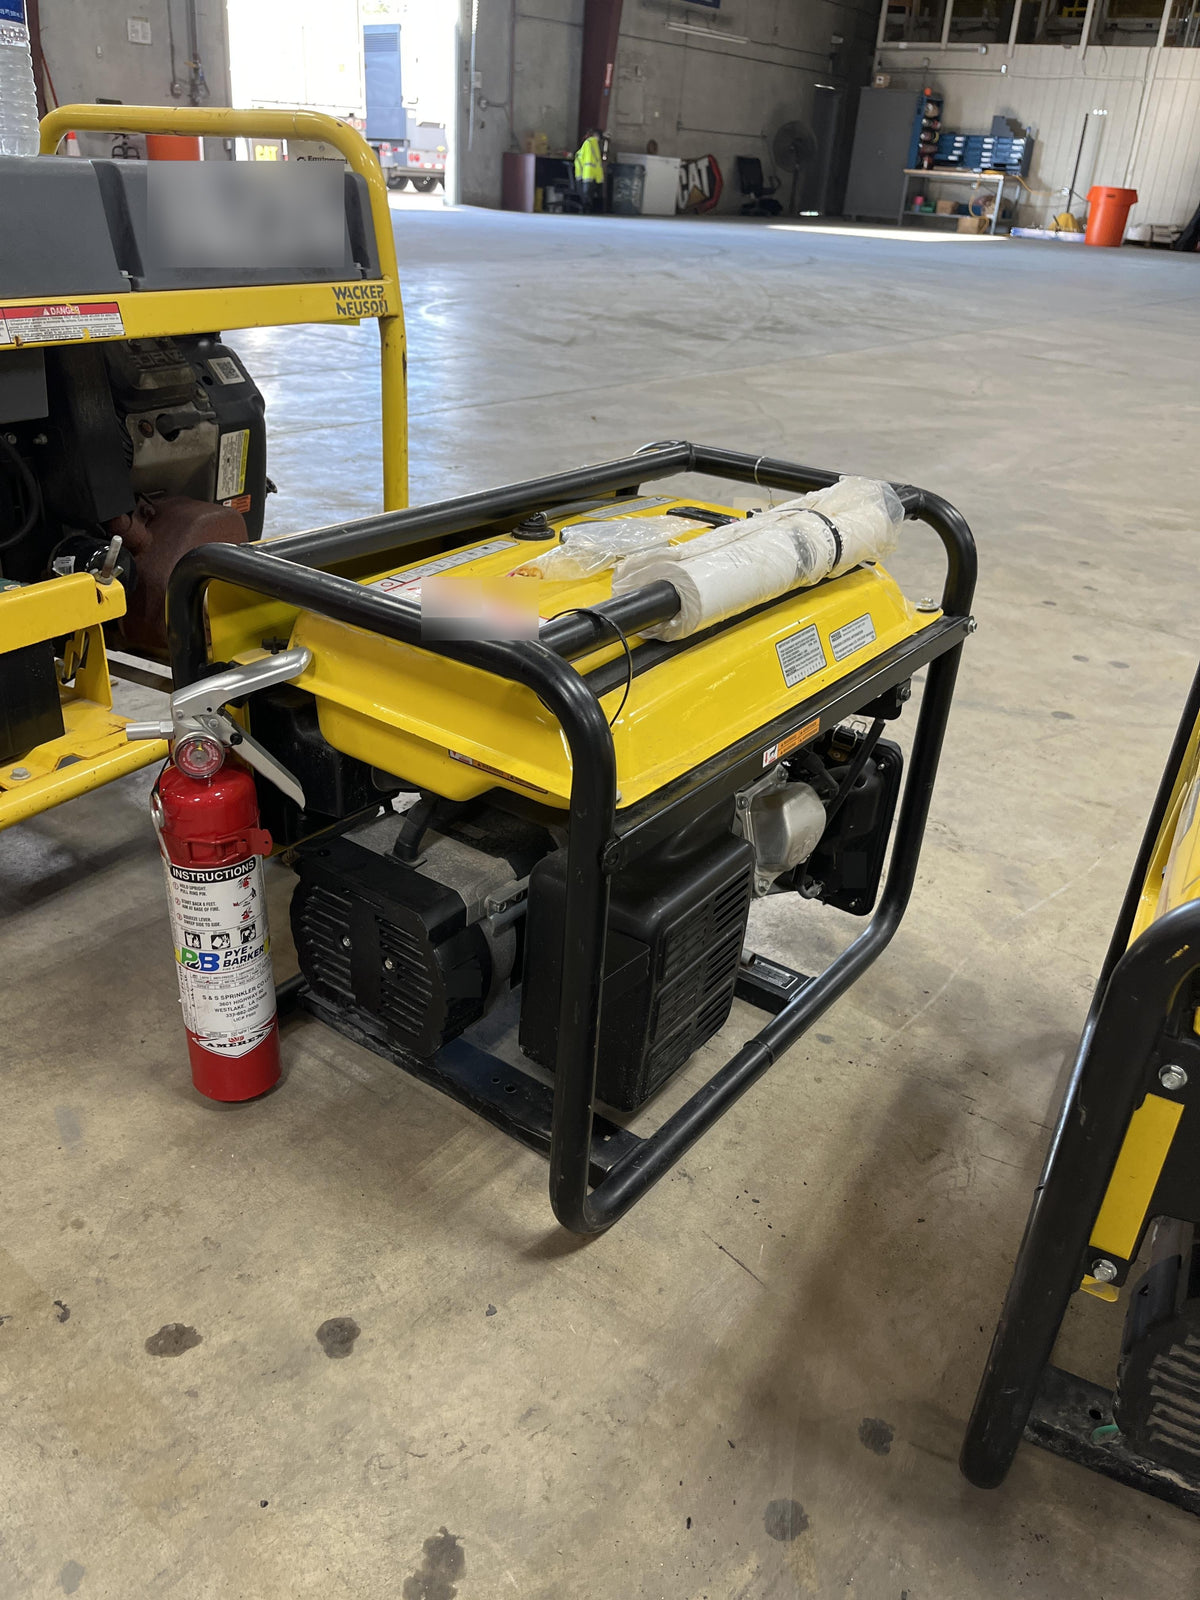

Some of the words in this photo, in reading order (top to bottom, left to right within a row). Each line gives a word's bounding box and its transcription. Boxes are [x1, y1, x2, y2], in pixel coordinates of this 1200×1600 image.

[678, 157, 711, 209] CAT
[331, 285, 385, 300] WACKER
[335, 299, 389, 316] NEUSON
[172, 859, 255, 882] INSTRUCTIONS
[223, 944, 264, 967] BARKER
[220, 986, 257, 1001] SPRINKLER
[233, 993, 258, 1005] HIGHWAY
[206, 1032, 265, 1048] AMEREX
